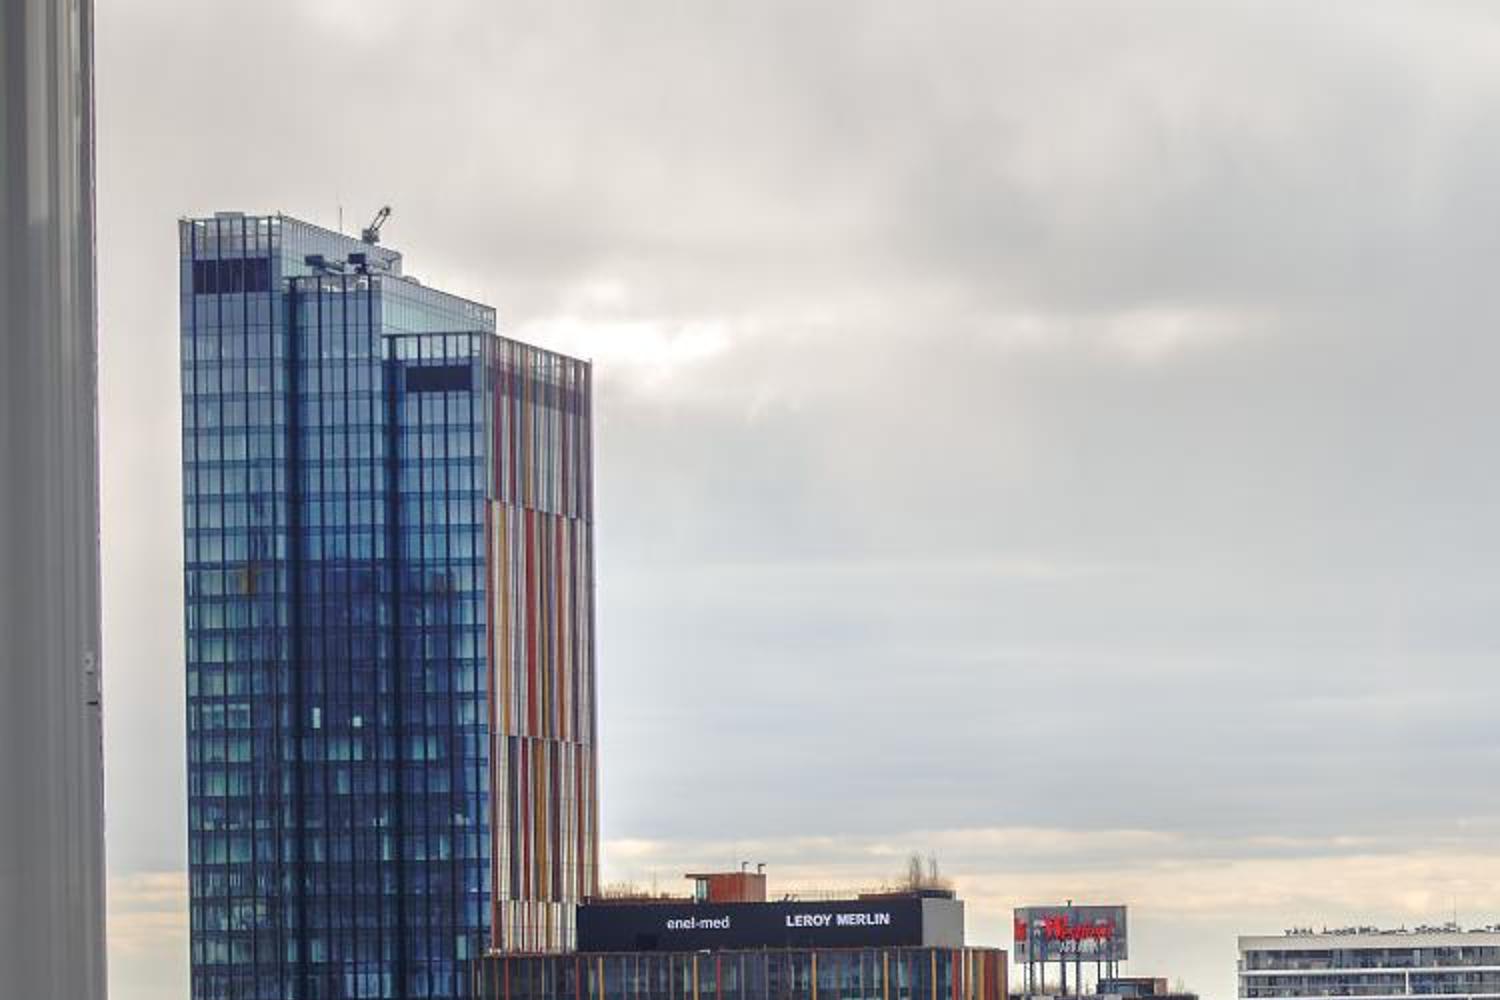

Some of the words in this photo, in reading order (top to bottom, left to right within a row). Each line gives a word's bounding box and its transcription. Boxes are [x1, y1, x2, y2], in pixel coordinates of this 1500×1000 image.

[667, 916, 730, 929] enel-med
[786, 914, 832, 927] LEROY
[837, 913, 890, 926] MERLIN
